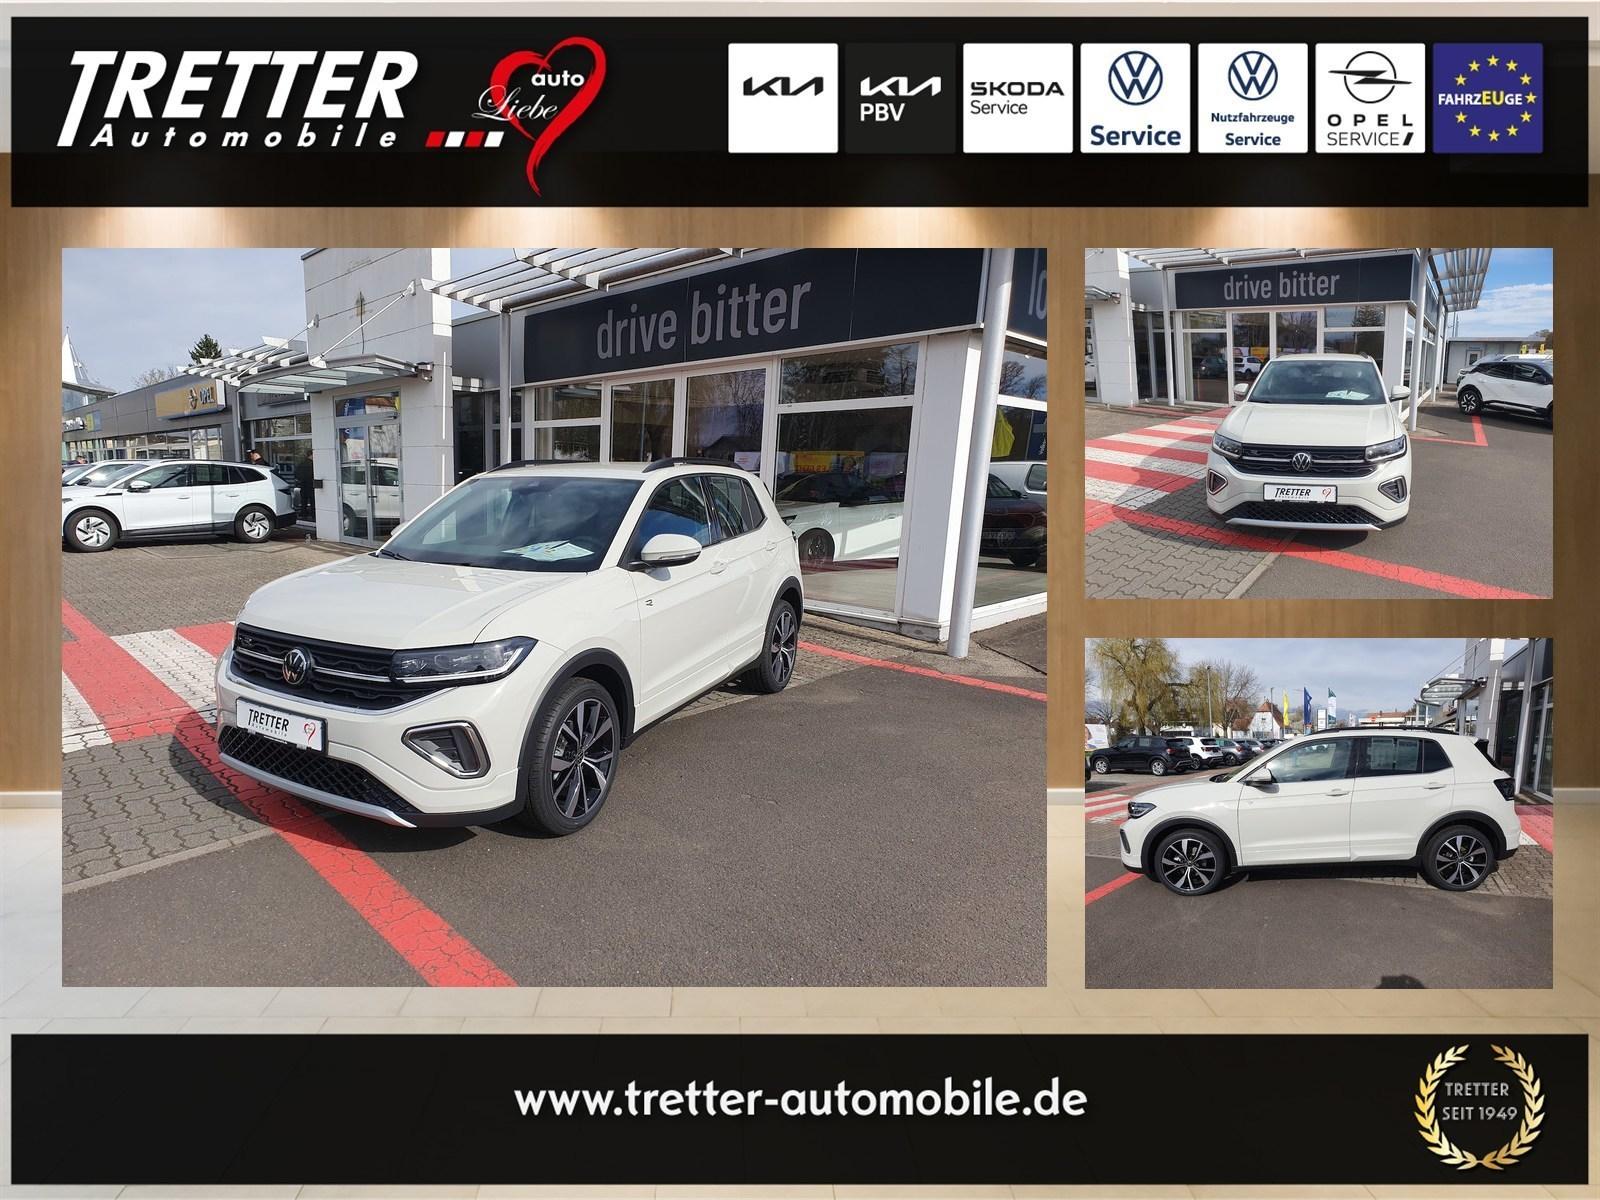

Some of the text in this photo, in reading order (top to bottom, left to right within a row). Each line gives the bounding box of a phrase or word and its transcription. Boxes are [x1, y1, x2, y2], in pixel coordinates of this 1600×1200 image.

[1223, 270, 1340, 300] drive bitter
[596, 281, 812, 360] drive bitter
[1274, 487, 1311, 498] TRETTER
[248, 709, 289, 732] TRETTER
